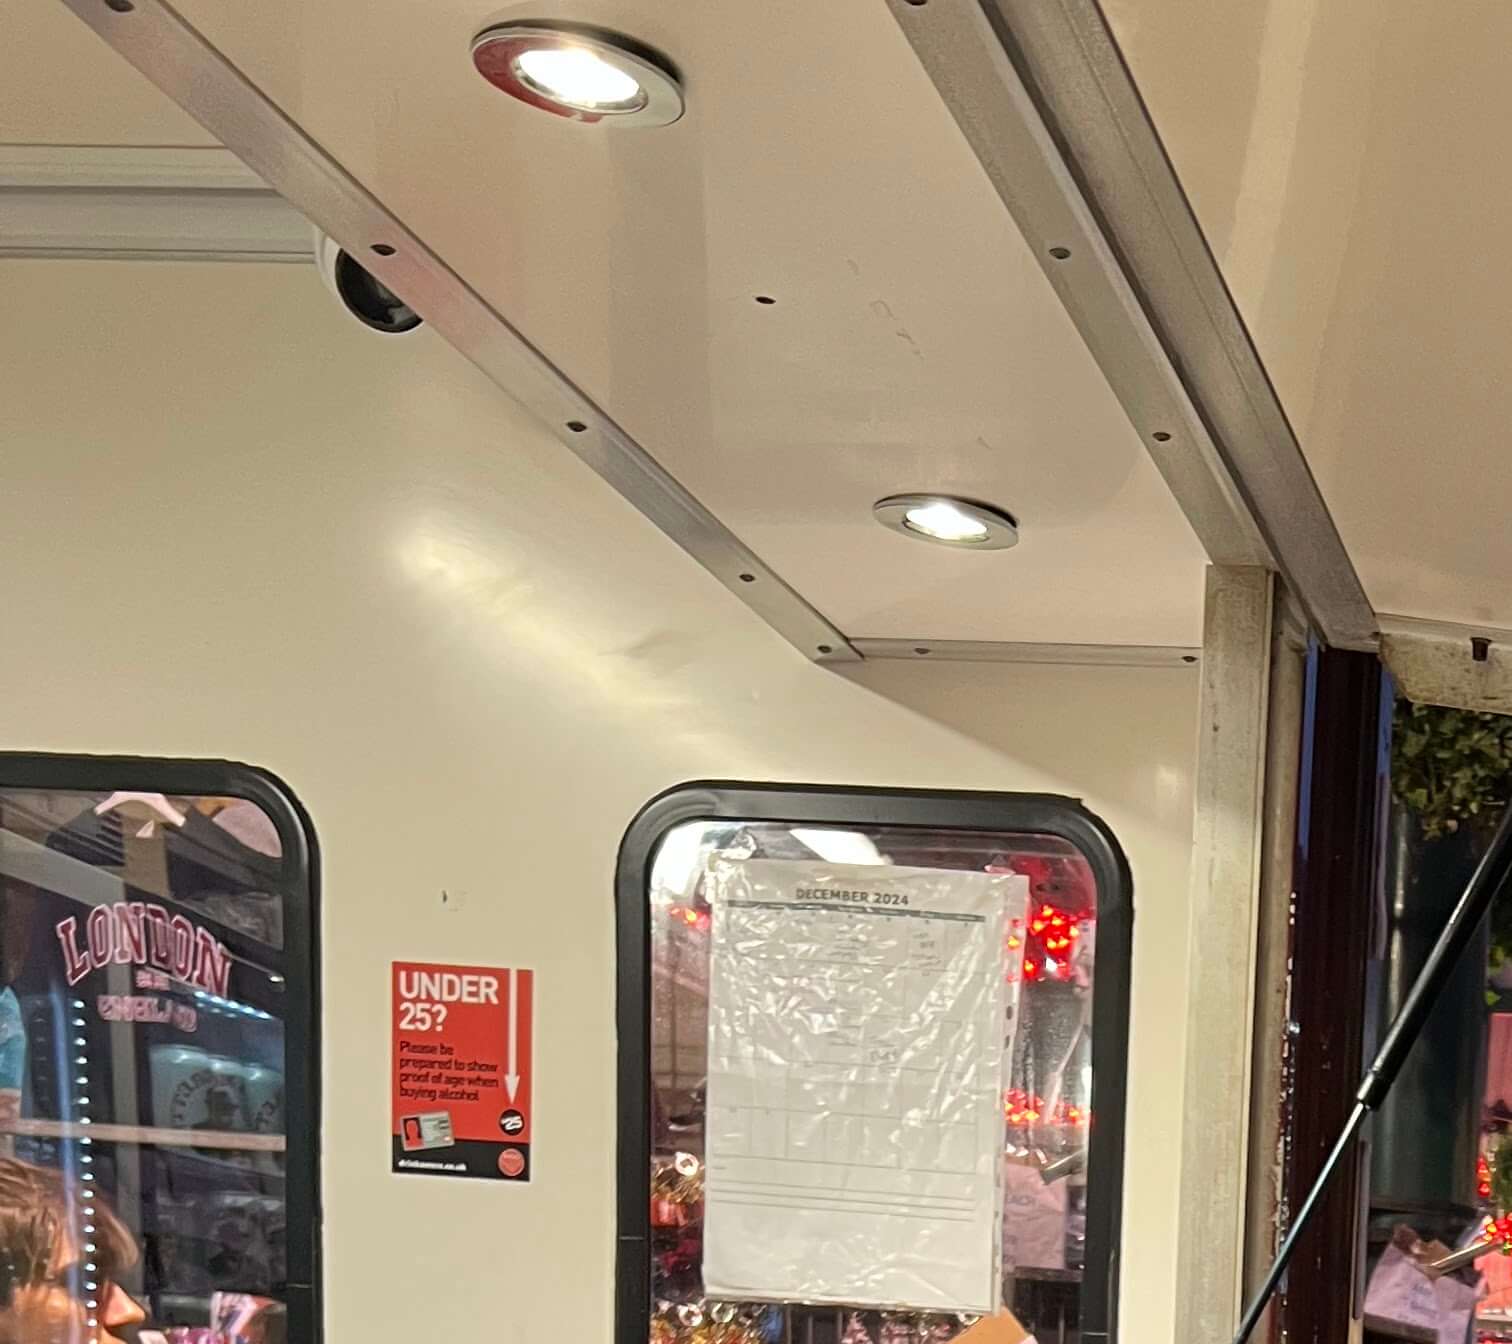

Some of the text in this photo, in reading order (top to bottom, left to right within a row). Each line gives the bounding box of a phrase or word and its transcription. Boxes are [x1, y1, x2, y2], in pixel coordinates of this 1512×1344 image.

[795, 888, 910, 906] DECEMBER 2024
[56, 902, 233, 998] LONDON
[399, 971, 500, 1005] UNDER
[399, 1002, 448, 1032] 25?
[400, 1041, 454, 1056] Please be
[400, 1058, 498, 1072] prepared to show
[400, 1072, 499, 1089] proof of age when
[400, 1086, 437, 1102] buying
